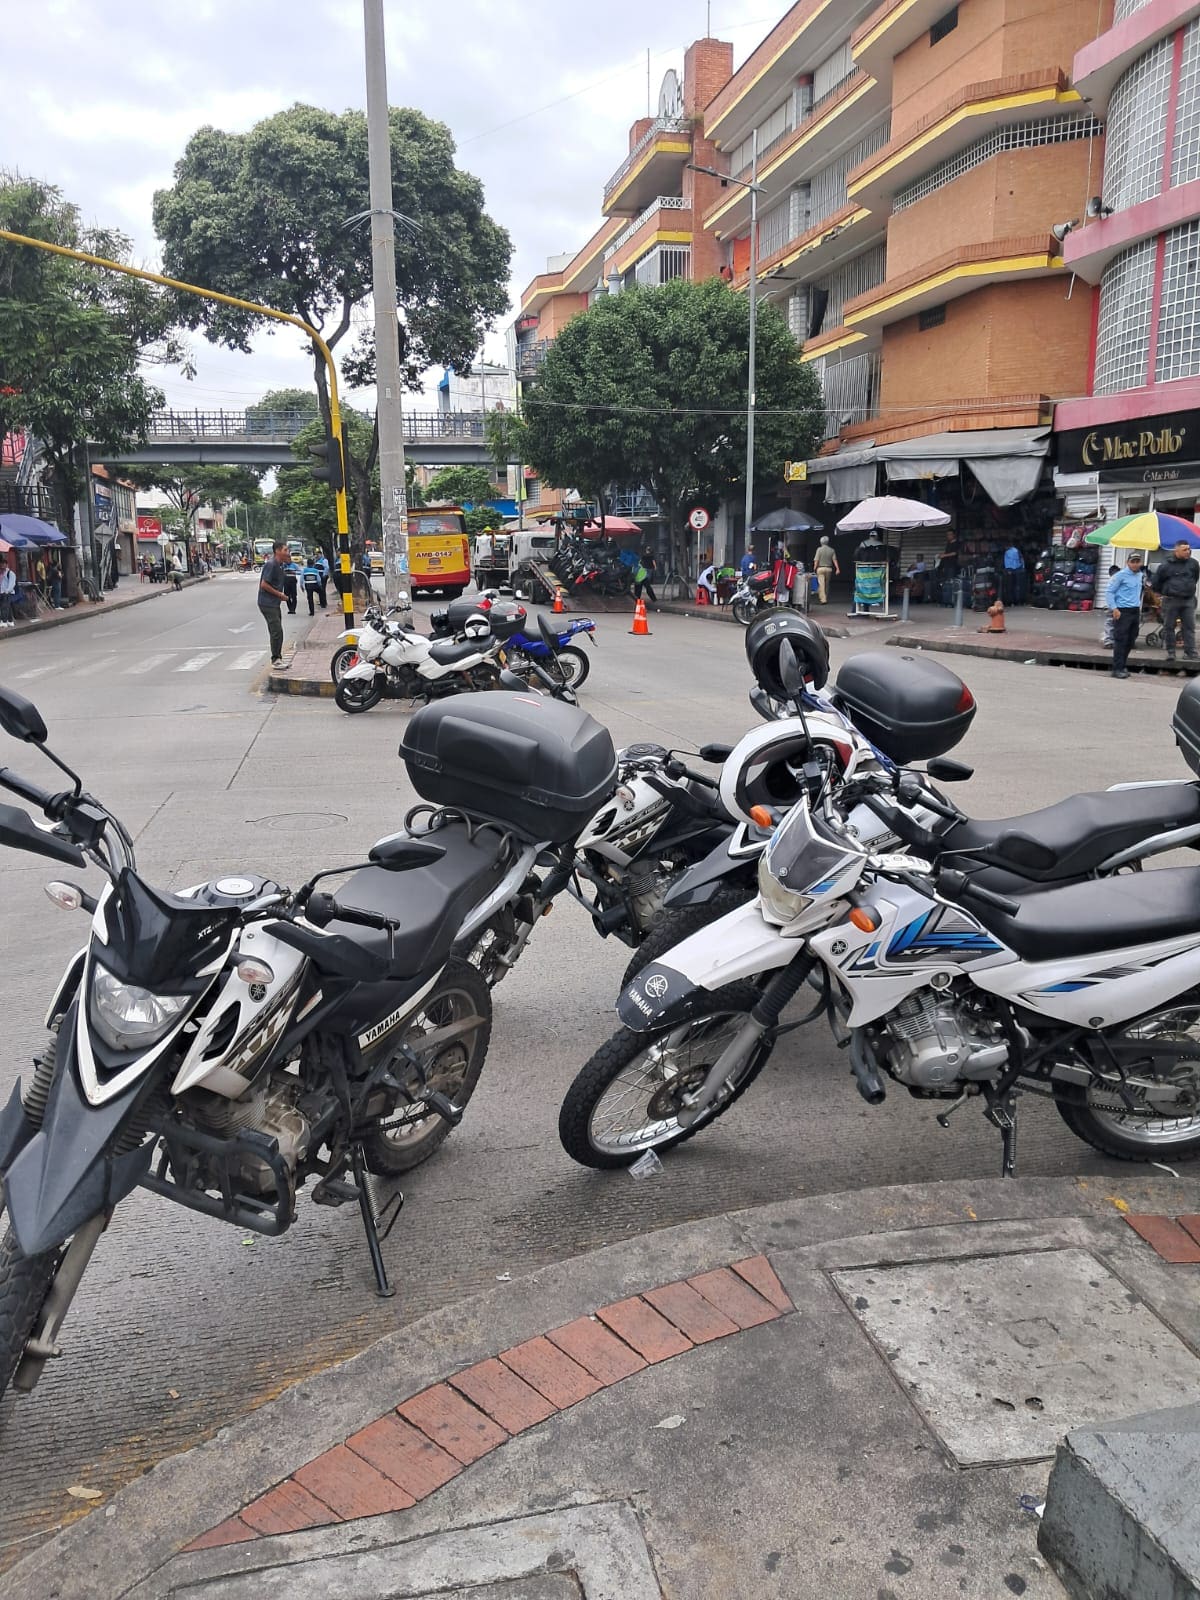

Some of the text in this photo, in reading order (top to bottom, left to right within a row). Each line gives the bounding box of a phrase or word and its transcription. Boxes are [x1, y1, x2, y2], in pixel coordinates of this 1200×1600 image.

[1103, 427, 1183, 461] Mac Pollo
[198, 925, 213, 940] XTZ
[628, 988, 654, 1018] YAMAHA
[365, 1011, 401, 1042] YAMAHA
